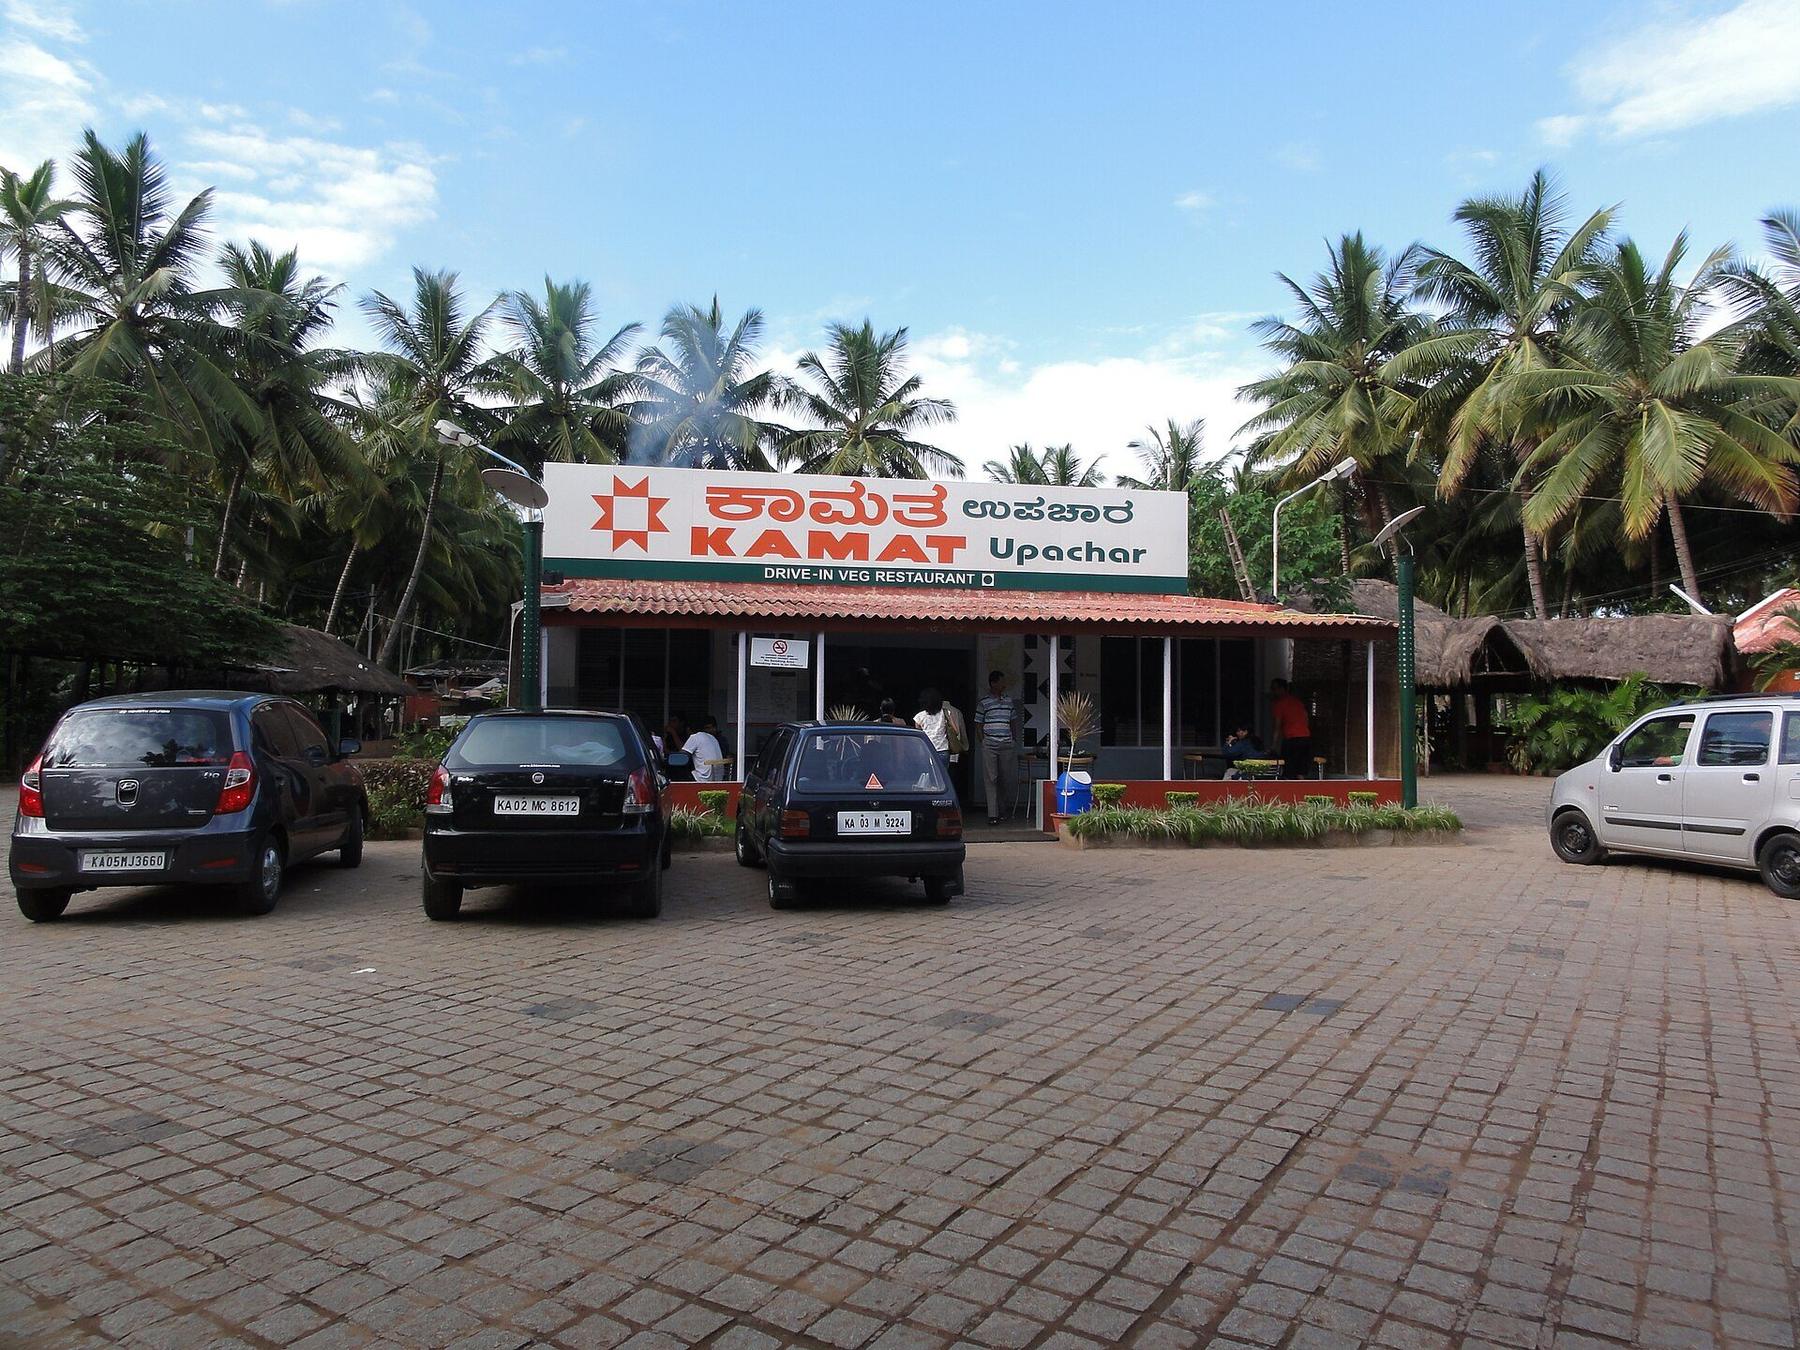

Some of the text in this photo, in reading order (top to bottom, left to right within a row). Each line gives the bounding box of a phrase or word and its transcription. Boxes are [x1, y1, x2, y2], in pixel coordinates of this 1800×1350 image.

[706, 480, 1134, 528] ಕಾಮತ ಉಪಚಾರ
[690, 526, 1148, 566] KAMAT Upachar
[764, 567, 976, 585] DRIVE-IN VEG RESTAURANT
[531, 800, 547, 811] MC
[550, 801, 577, 812] 8612
[844, 818, 855, 828] KA
[860, 818, 869, 828] 03
[885, 818, 905, 828] 9224
[91, 855, 163, 868] KA05MJ3660
